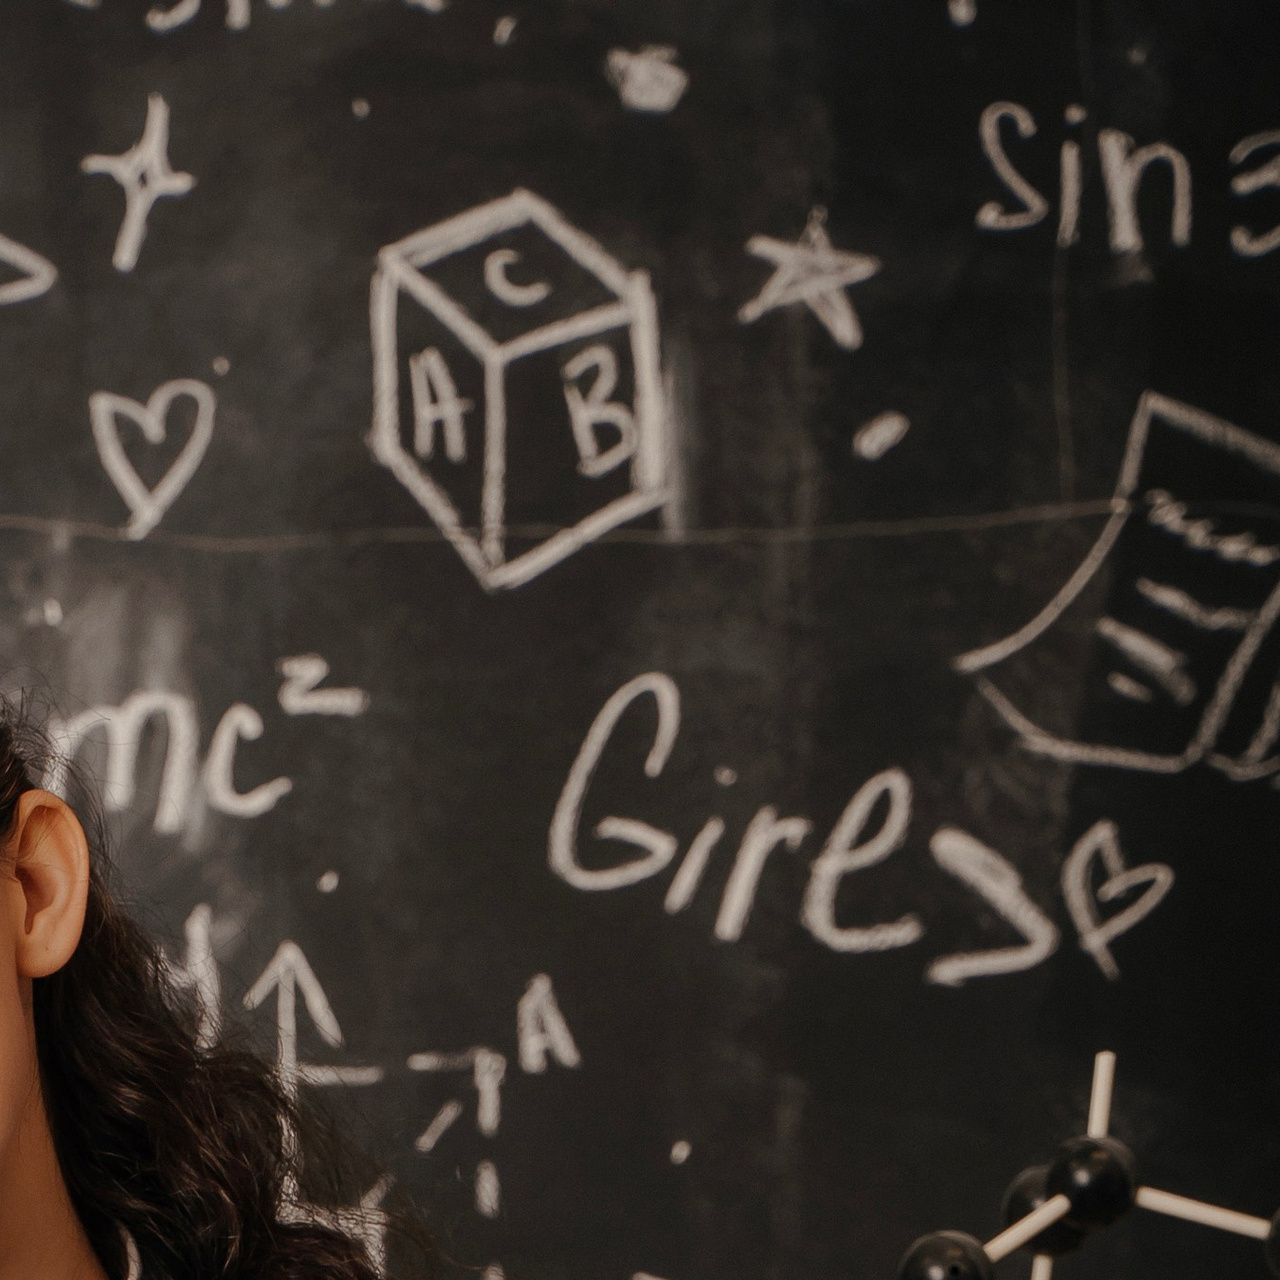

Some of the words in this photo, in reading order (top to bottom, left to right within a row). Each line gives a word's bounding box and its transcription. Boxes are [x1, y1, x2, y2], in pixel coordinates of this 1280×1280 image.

[484, 249, 549, 306] C
[410, 347, 471, 461] A
[564, 346, 636, 477] B
